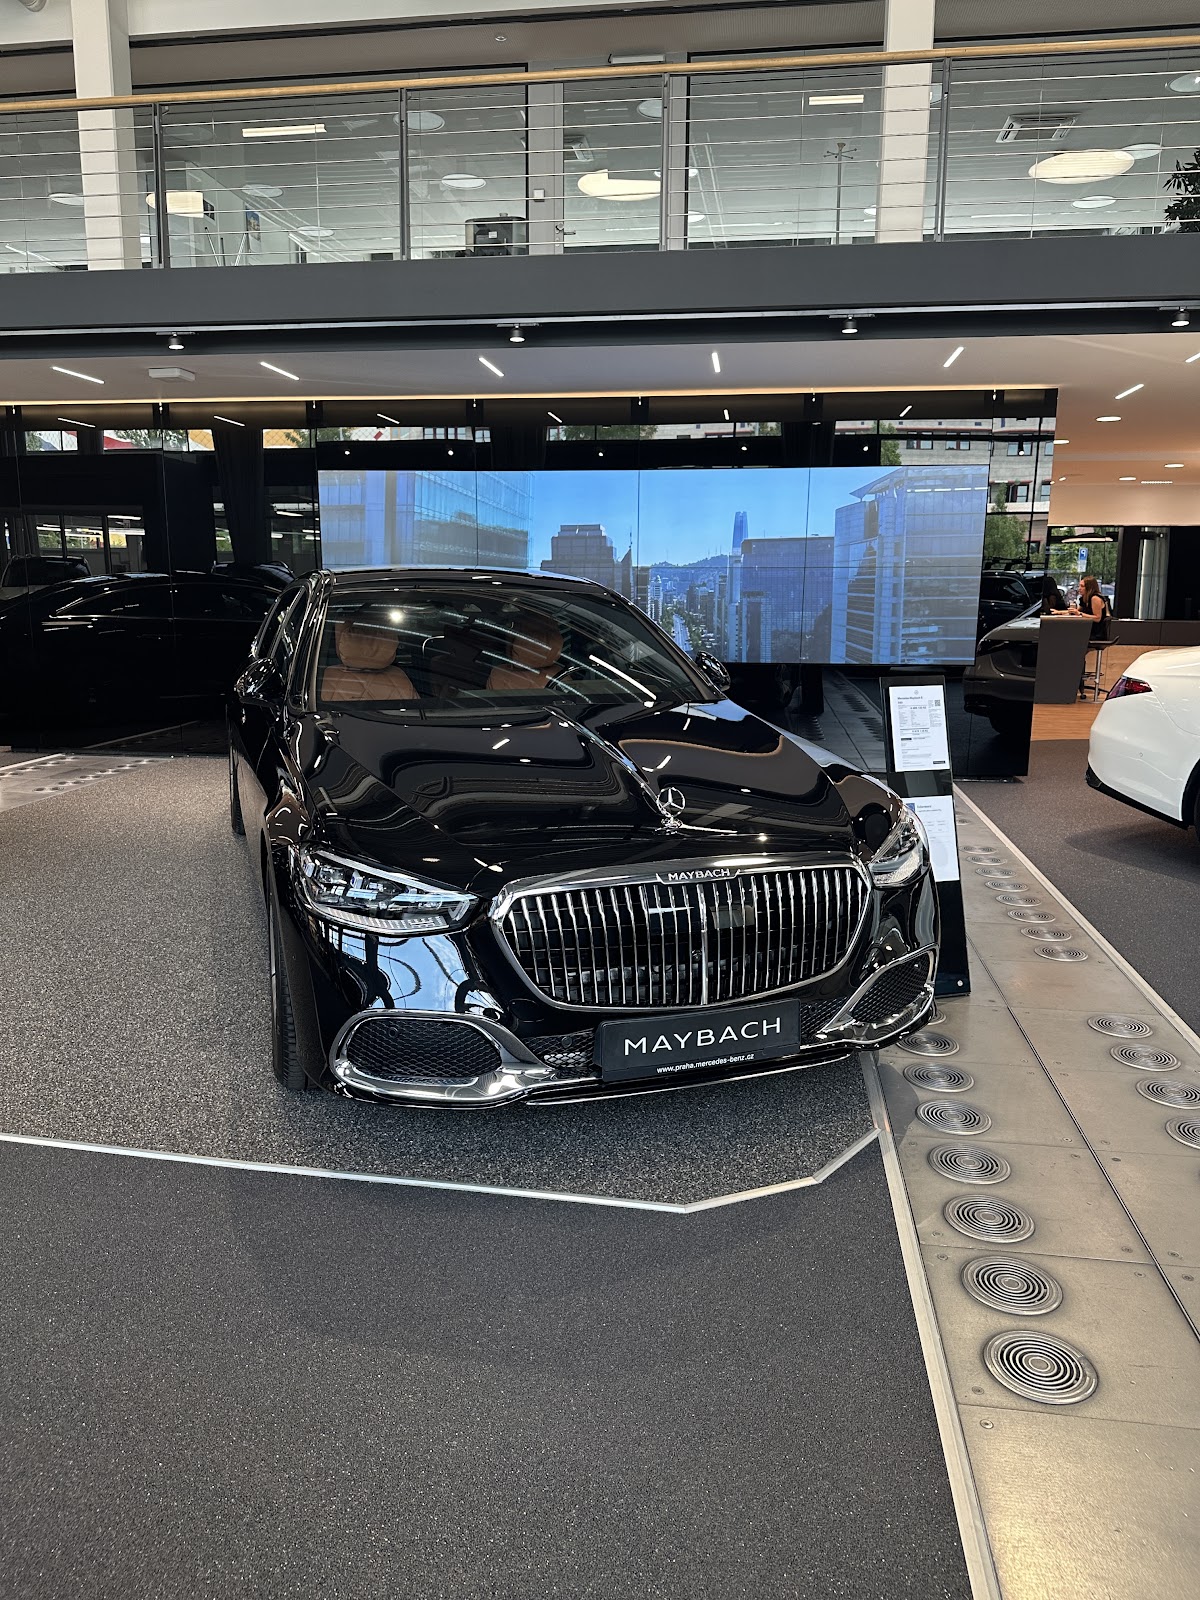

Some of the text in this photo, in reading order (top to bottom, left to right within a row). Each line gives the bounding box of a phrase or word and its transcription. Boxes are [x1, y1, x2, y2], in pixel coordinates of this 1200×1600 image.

[667, 868, 730, 881] MAYBACH
[624, 1017, 781, 1056] MAYBACH
[656, 1053, 755, 1074] www.praha.mercedes-benz.cz
